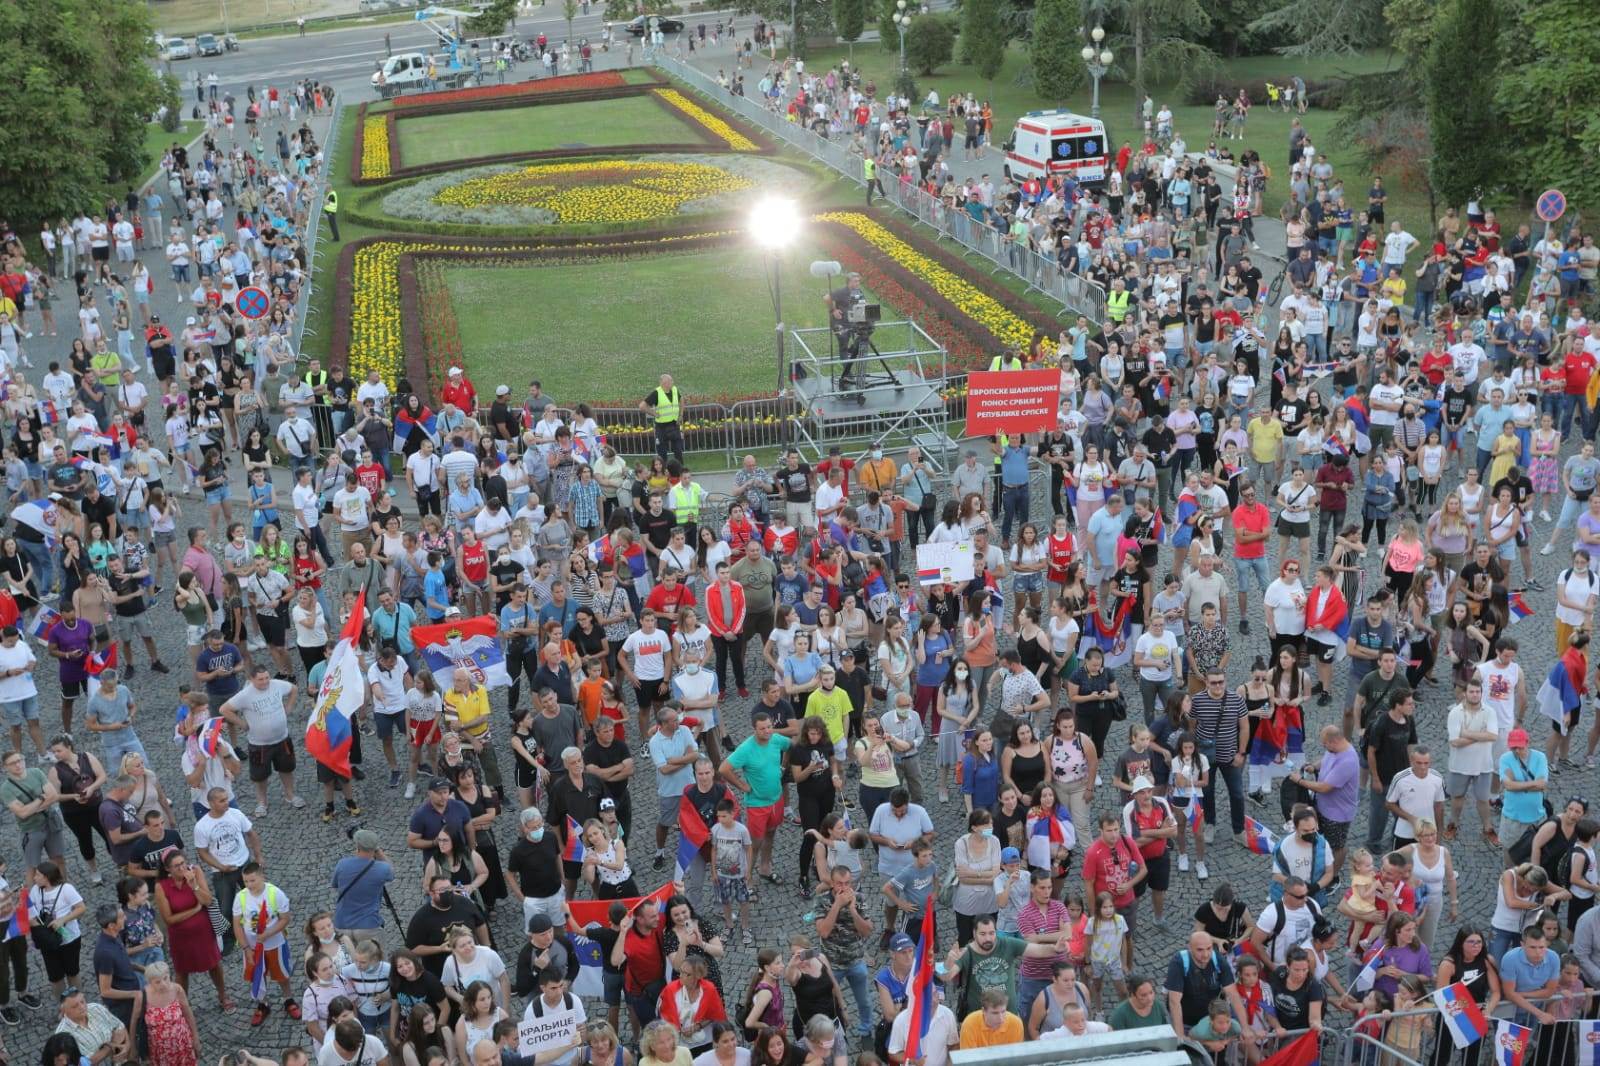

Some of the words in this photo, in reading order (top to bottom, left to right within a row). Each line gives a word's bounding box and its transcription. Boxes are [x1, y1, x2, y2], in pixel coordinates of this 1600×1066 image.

[970, 388, 1008, 396] ЕВРОПСКЕ
[1009, 385, 1058, 394] ШАМПИОНКЕ
[981, 399, 1008, 407] ПОНОС
[1021, 407, 1049, 416] СРПСКЕ
[520, 1016, 574, 1037] КРАЉИЦЕ
[526, 1028, 570, 1046] СПОРТА
